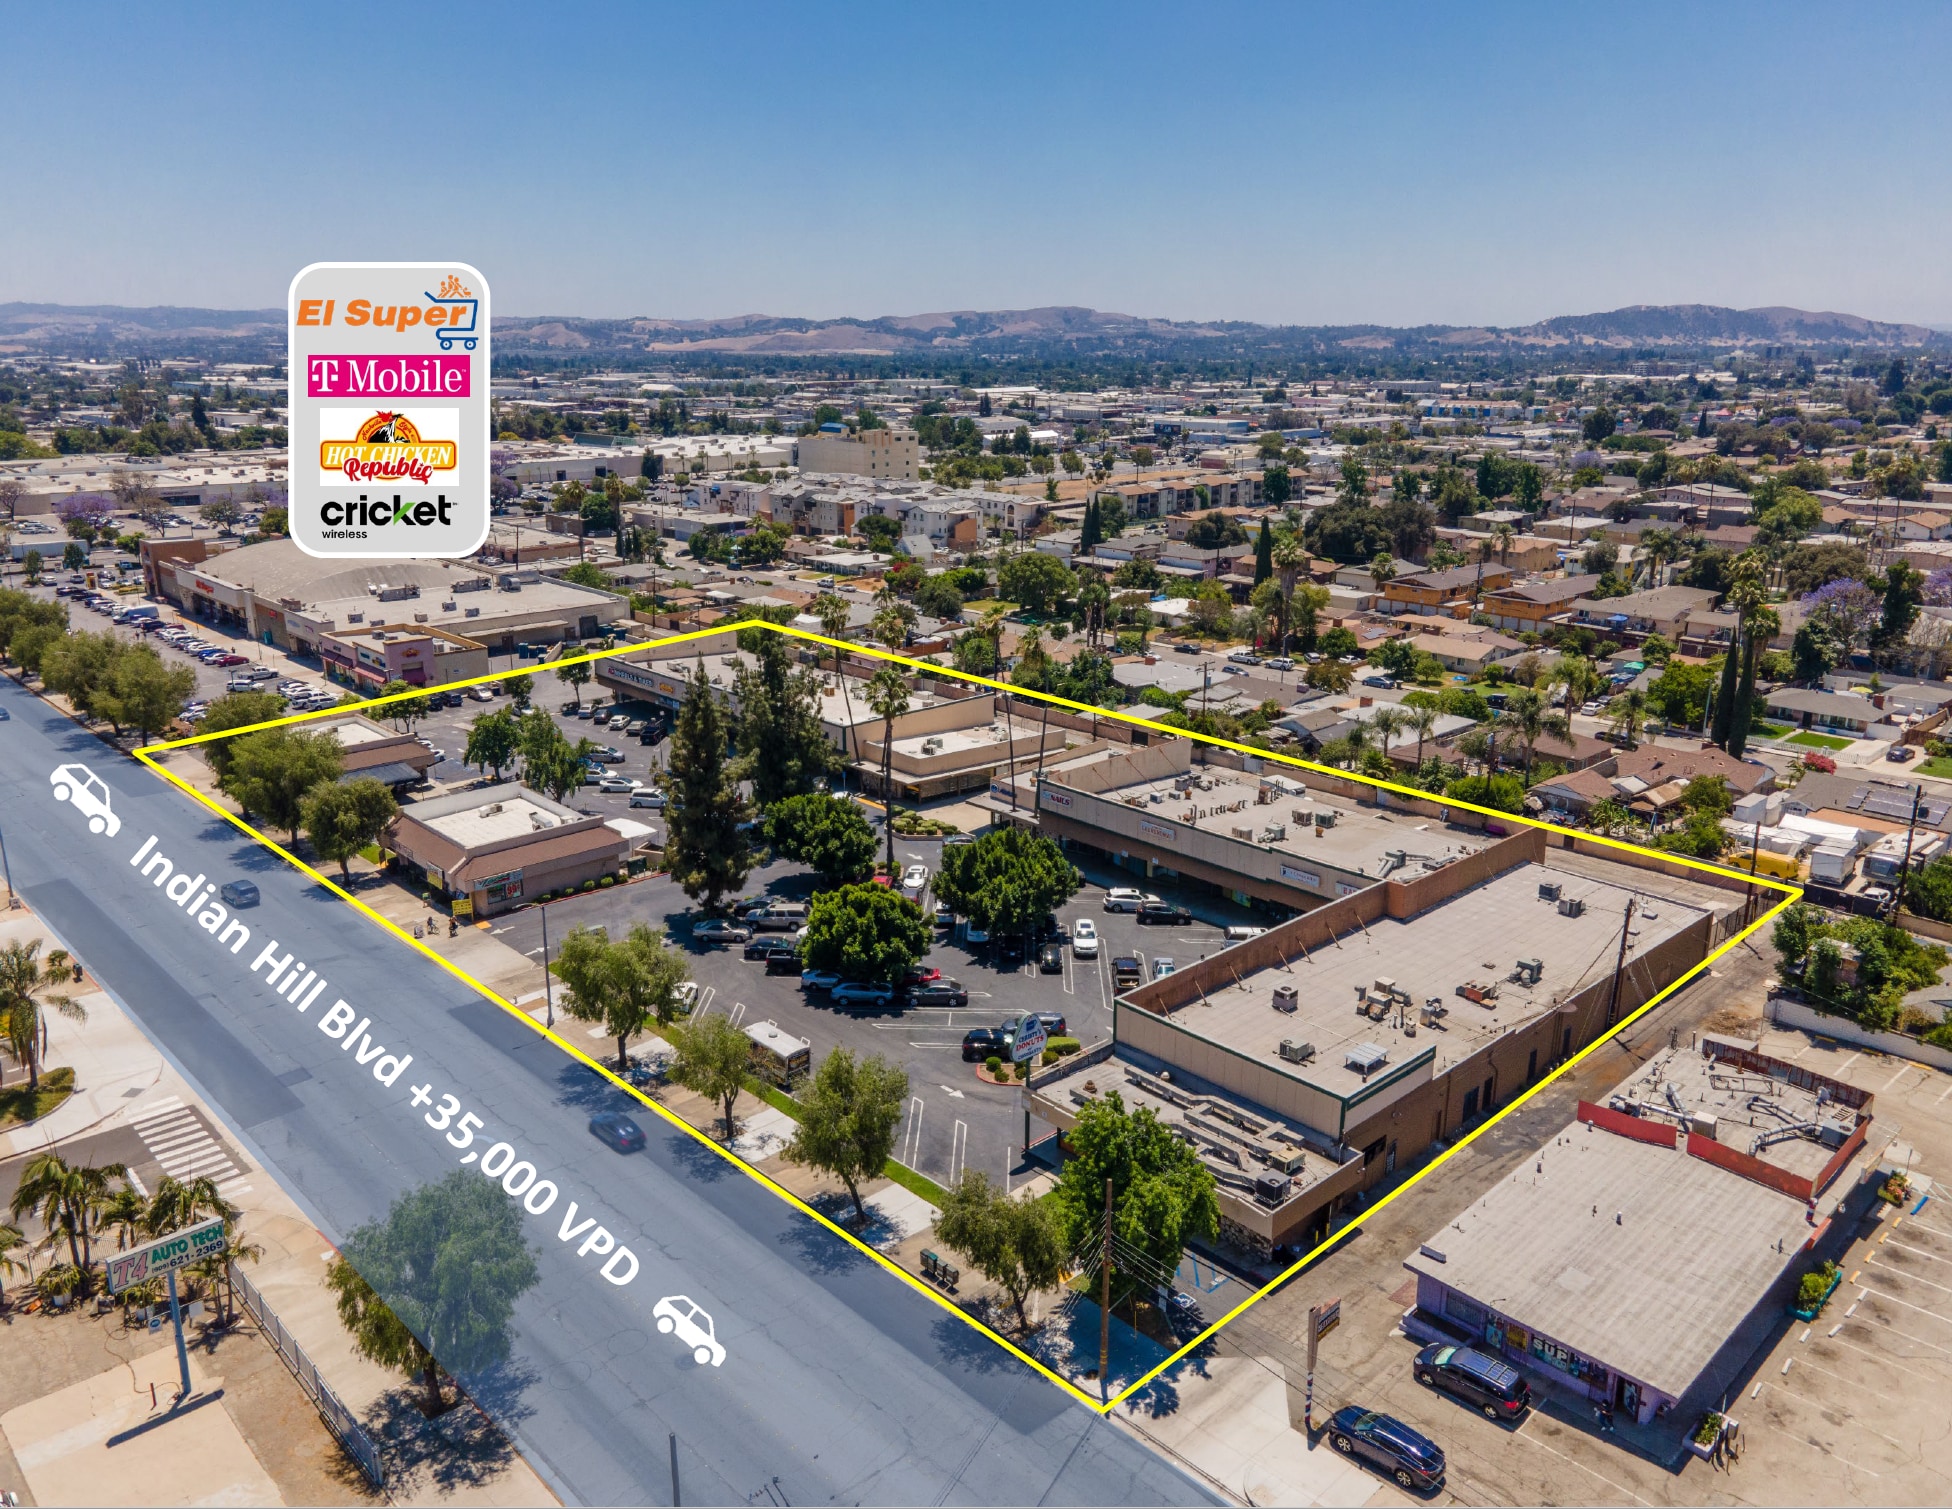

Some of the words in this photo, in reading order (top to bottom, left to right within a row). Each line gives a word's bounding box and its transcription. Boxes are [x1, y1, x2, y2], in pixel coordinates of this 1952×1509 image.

[1050, 794, 1071, 806] NAILS
[1016, 1035, 1044, 1052] DONUTS
[114, 1252, 148, 1289] T4
[151, 1238, 188, 1265] AUTO
[190, 1225, 222, 1247] TECH
